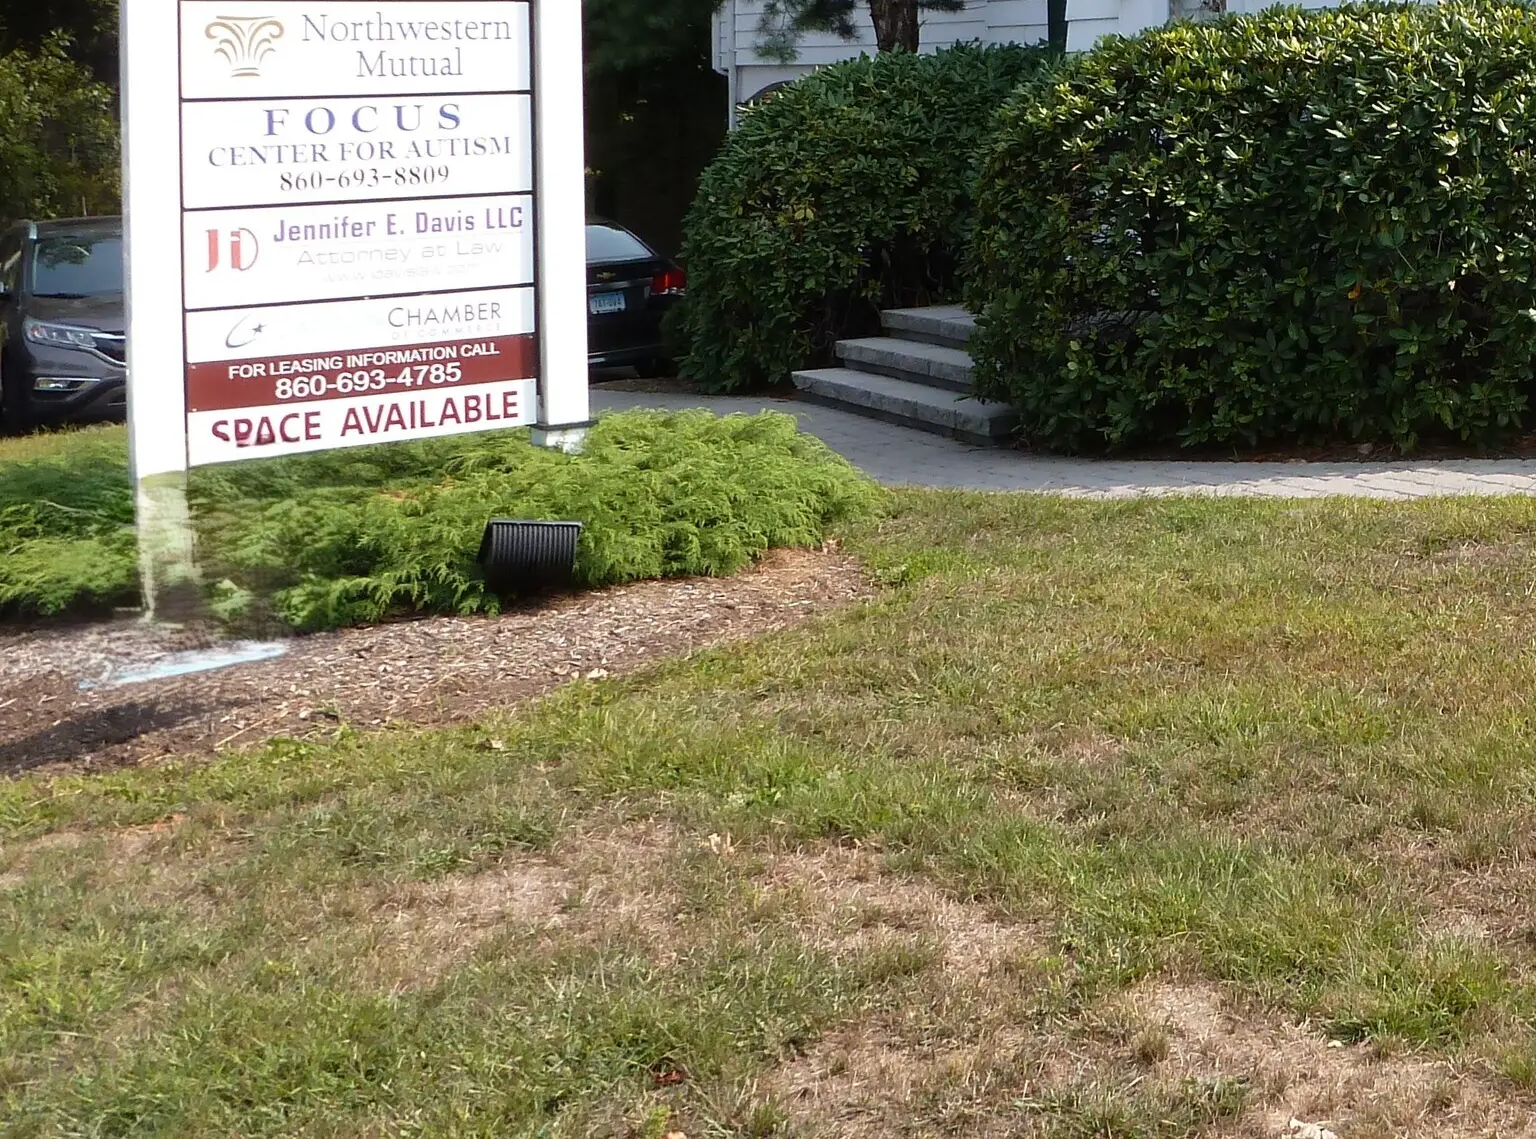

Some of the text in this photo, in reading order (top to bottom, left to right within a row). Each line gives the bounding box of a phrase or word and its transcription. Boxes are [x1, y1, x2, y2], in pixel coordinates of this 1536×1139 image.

[302, 12, 512, 42] Northwestern
[356, 47, 463, 78] Mutual
[263, 103, 462, 136] FOCUS
[208, 136, 512, 168] CENTER FOR AUTISM
[280, 165, 450, 193] 860-693-8809
[273, 206, 523, 243] Jennifer E. Davis LLC
[297, 239, 504, 268] Attorney at Law
[388, 302, 502, 328] CHAMBER
[228, 342, 500, 380] FOR LEASING INFORMATION CALL
[275, 362, 462, 399] 860-693-4785
[340, 390, 519, 437] AVAILABLE
